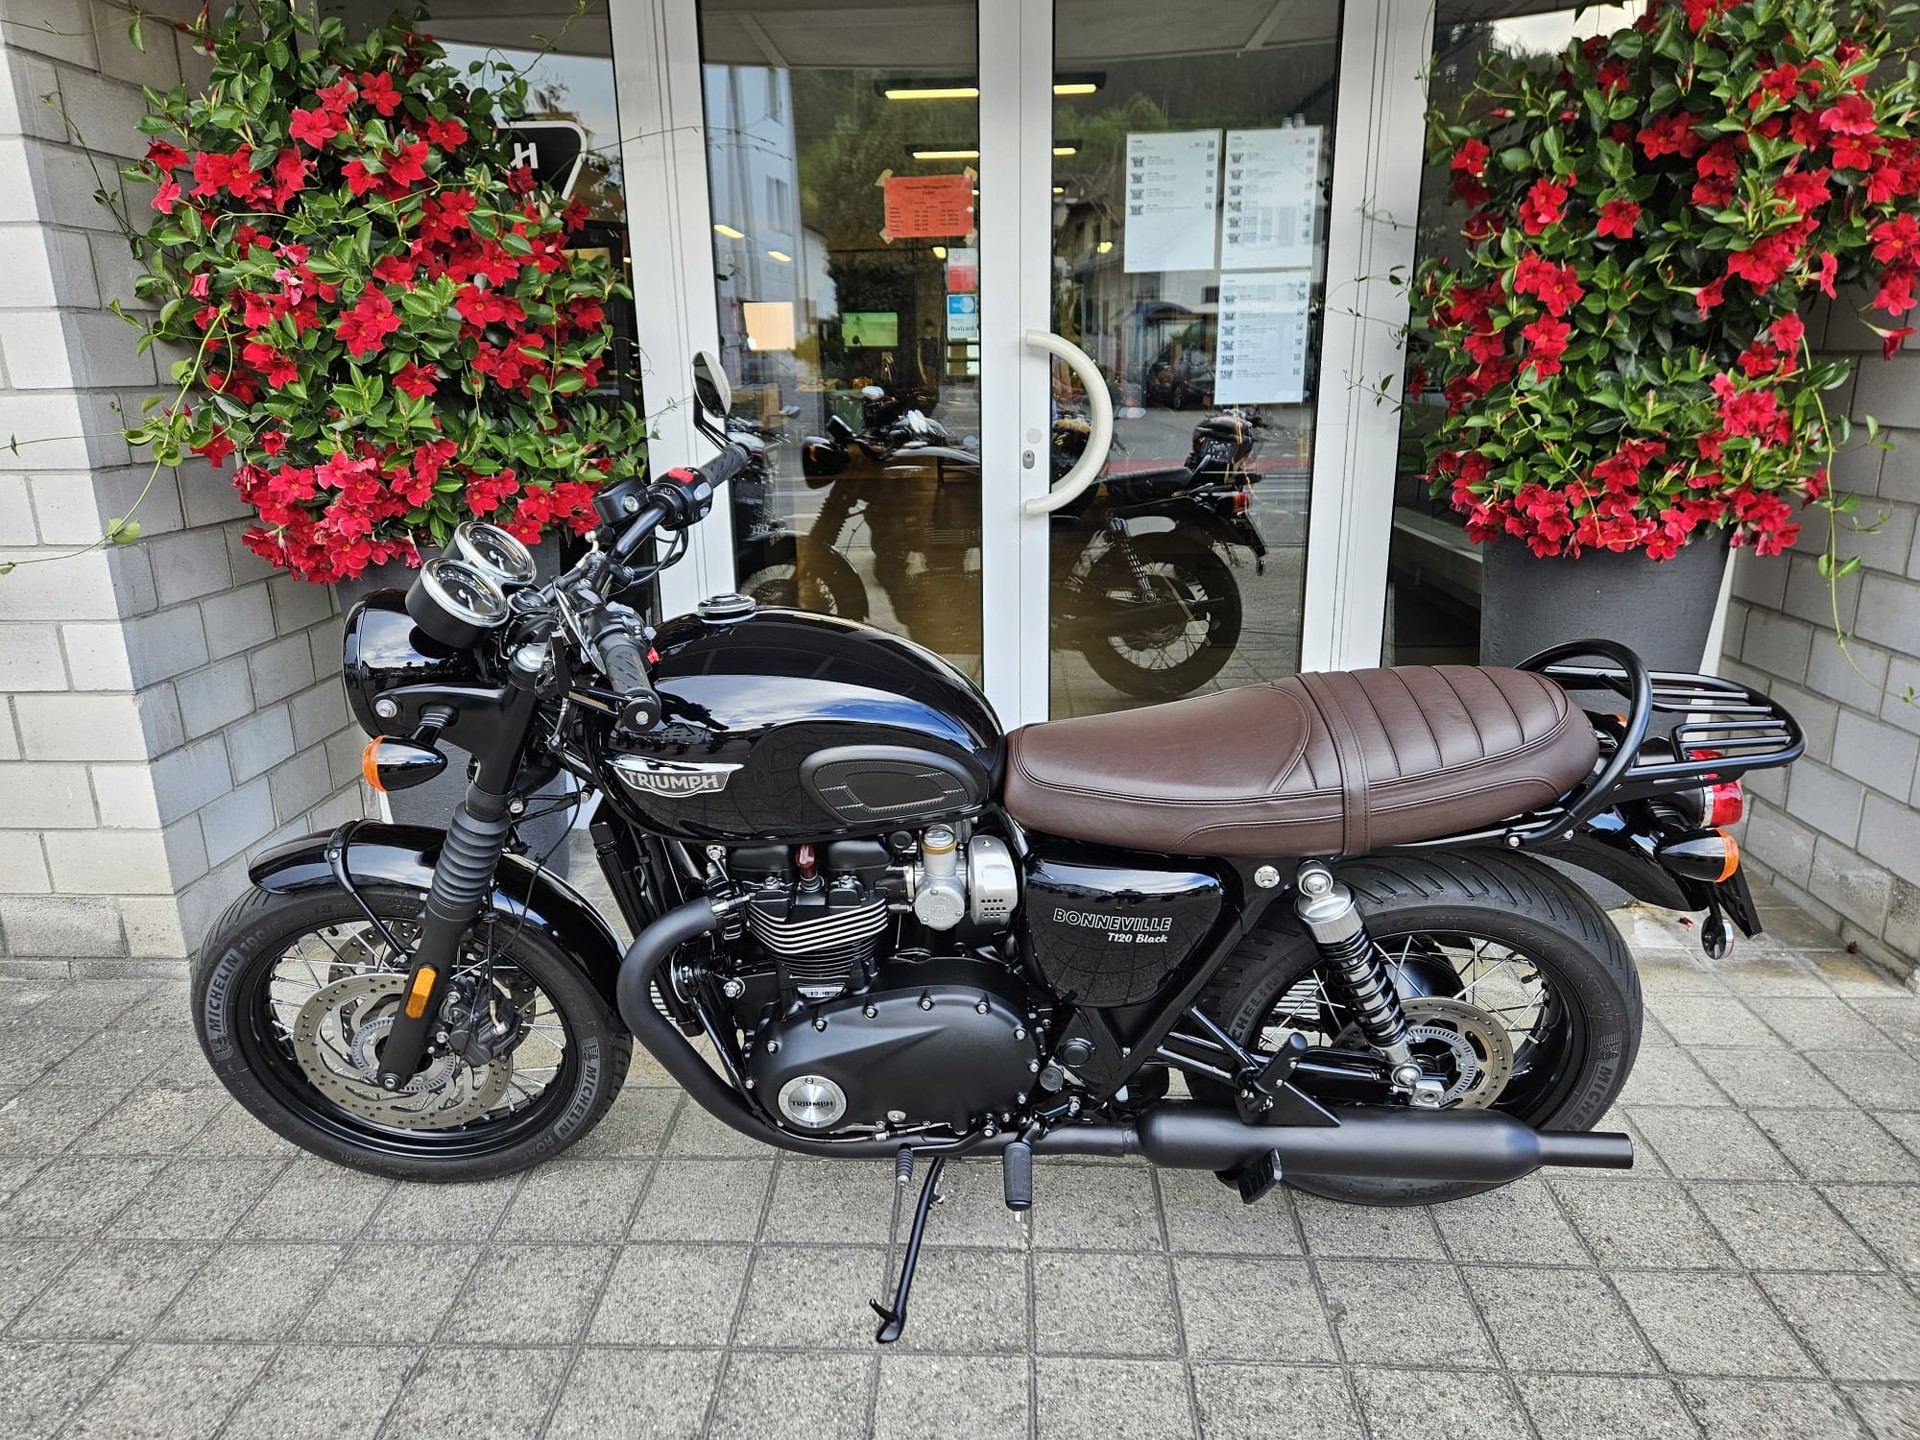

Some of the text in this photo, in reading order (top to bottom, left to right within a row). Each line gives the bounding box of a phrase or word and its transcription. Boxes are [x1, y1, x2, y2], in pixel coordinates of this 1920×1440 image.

[624, 769, 719, 791] TRIUMPH
[1052, 907, 1173, 932] BONNEVILLE
[1107, 932, 1168, 944] T120 Black
[208, 953, 240, 1034] MICHELIN
[558, 1065, 597, 1136] MICHELIN
[791, 1100, 834, 1108] TRIUMPH
